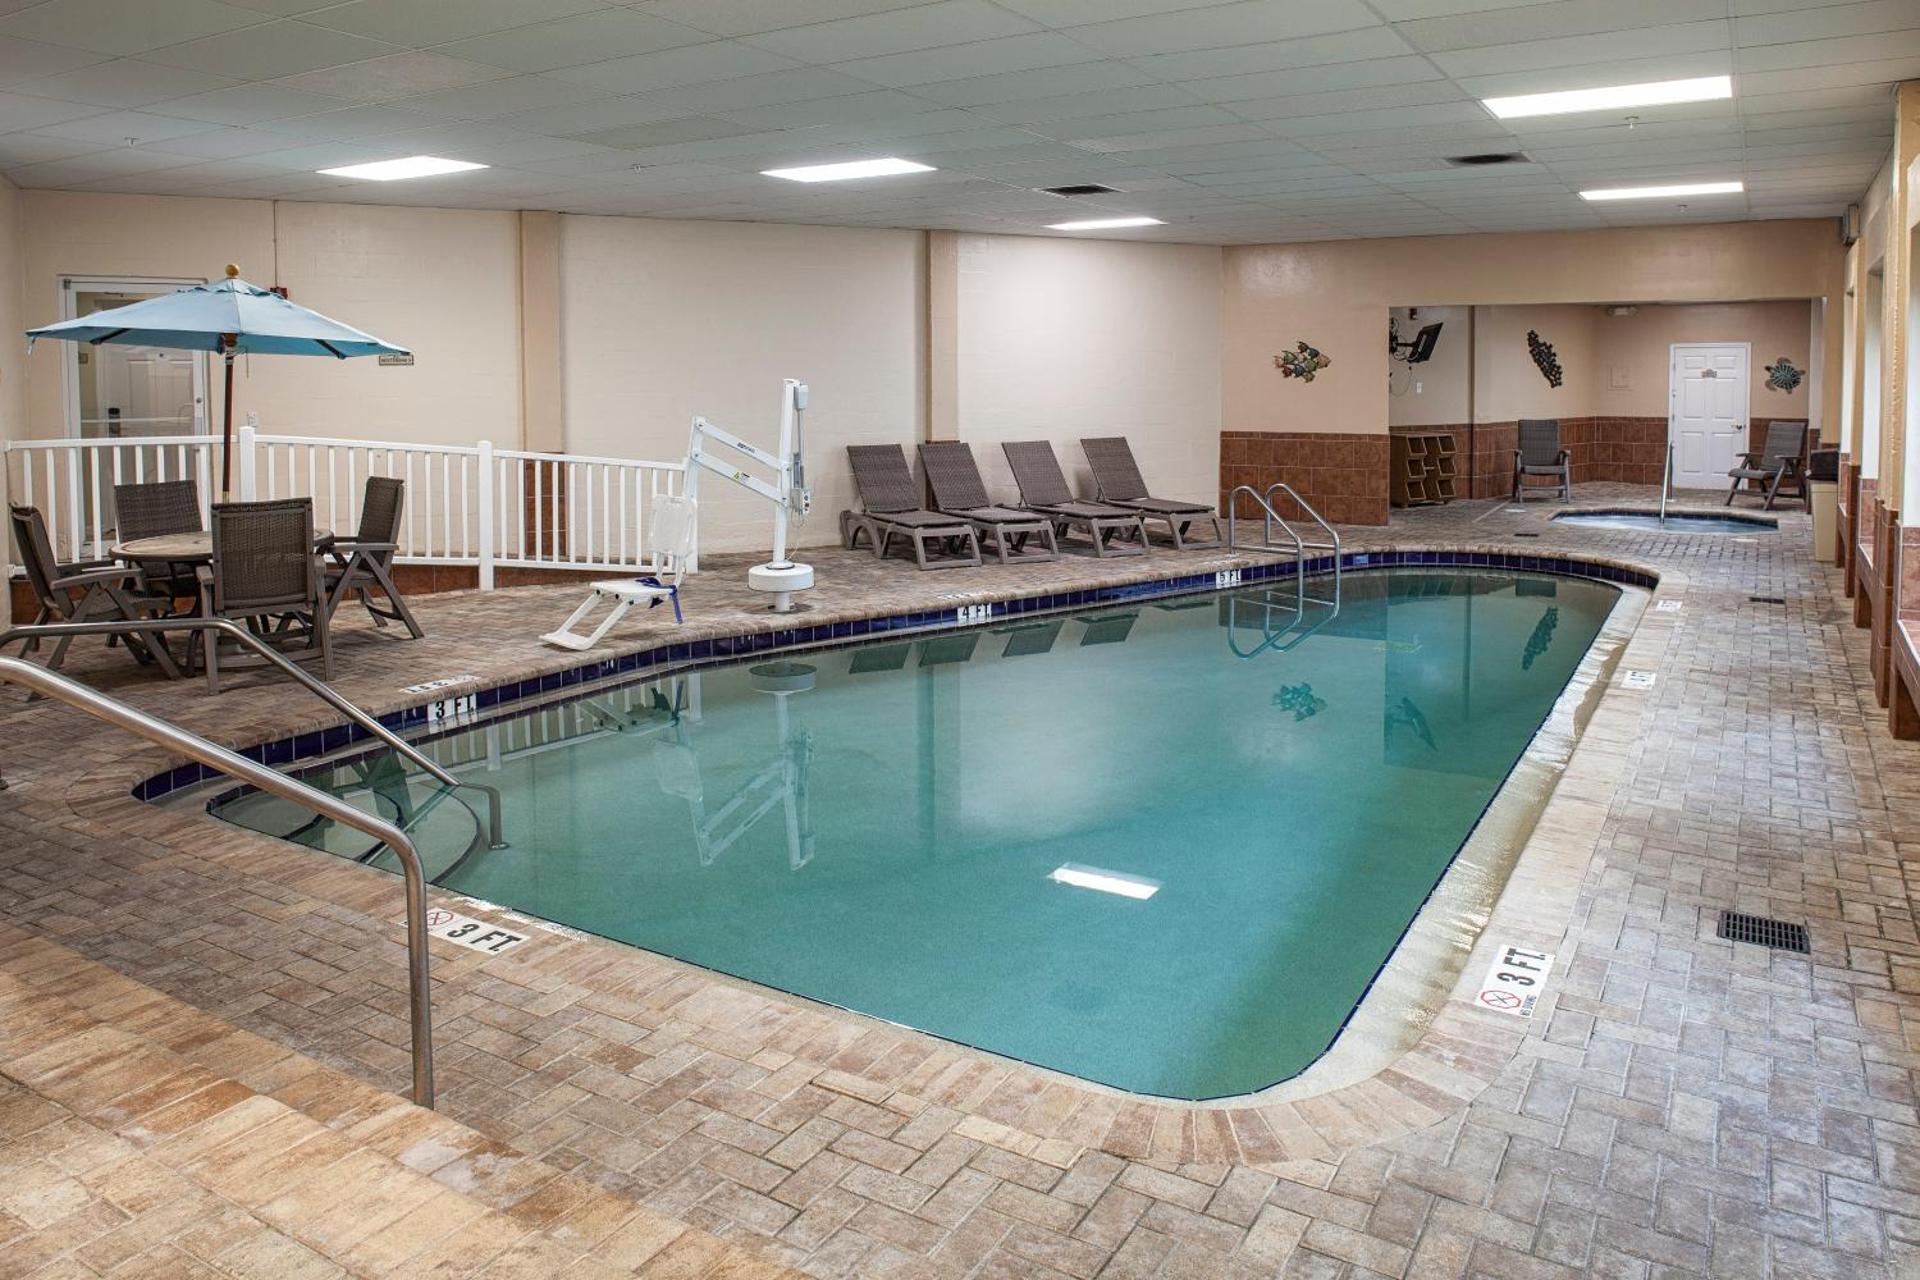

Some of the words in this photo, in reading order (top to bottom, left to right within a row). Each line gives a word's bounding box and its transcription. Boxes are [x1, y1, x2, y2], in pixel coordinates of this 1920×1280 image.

[962, 606, 970, 619] 4
[435, 701, 445, 718] 3
[447, 923, 480, 938] 3
[1496, 972, 1536, 987] 3
